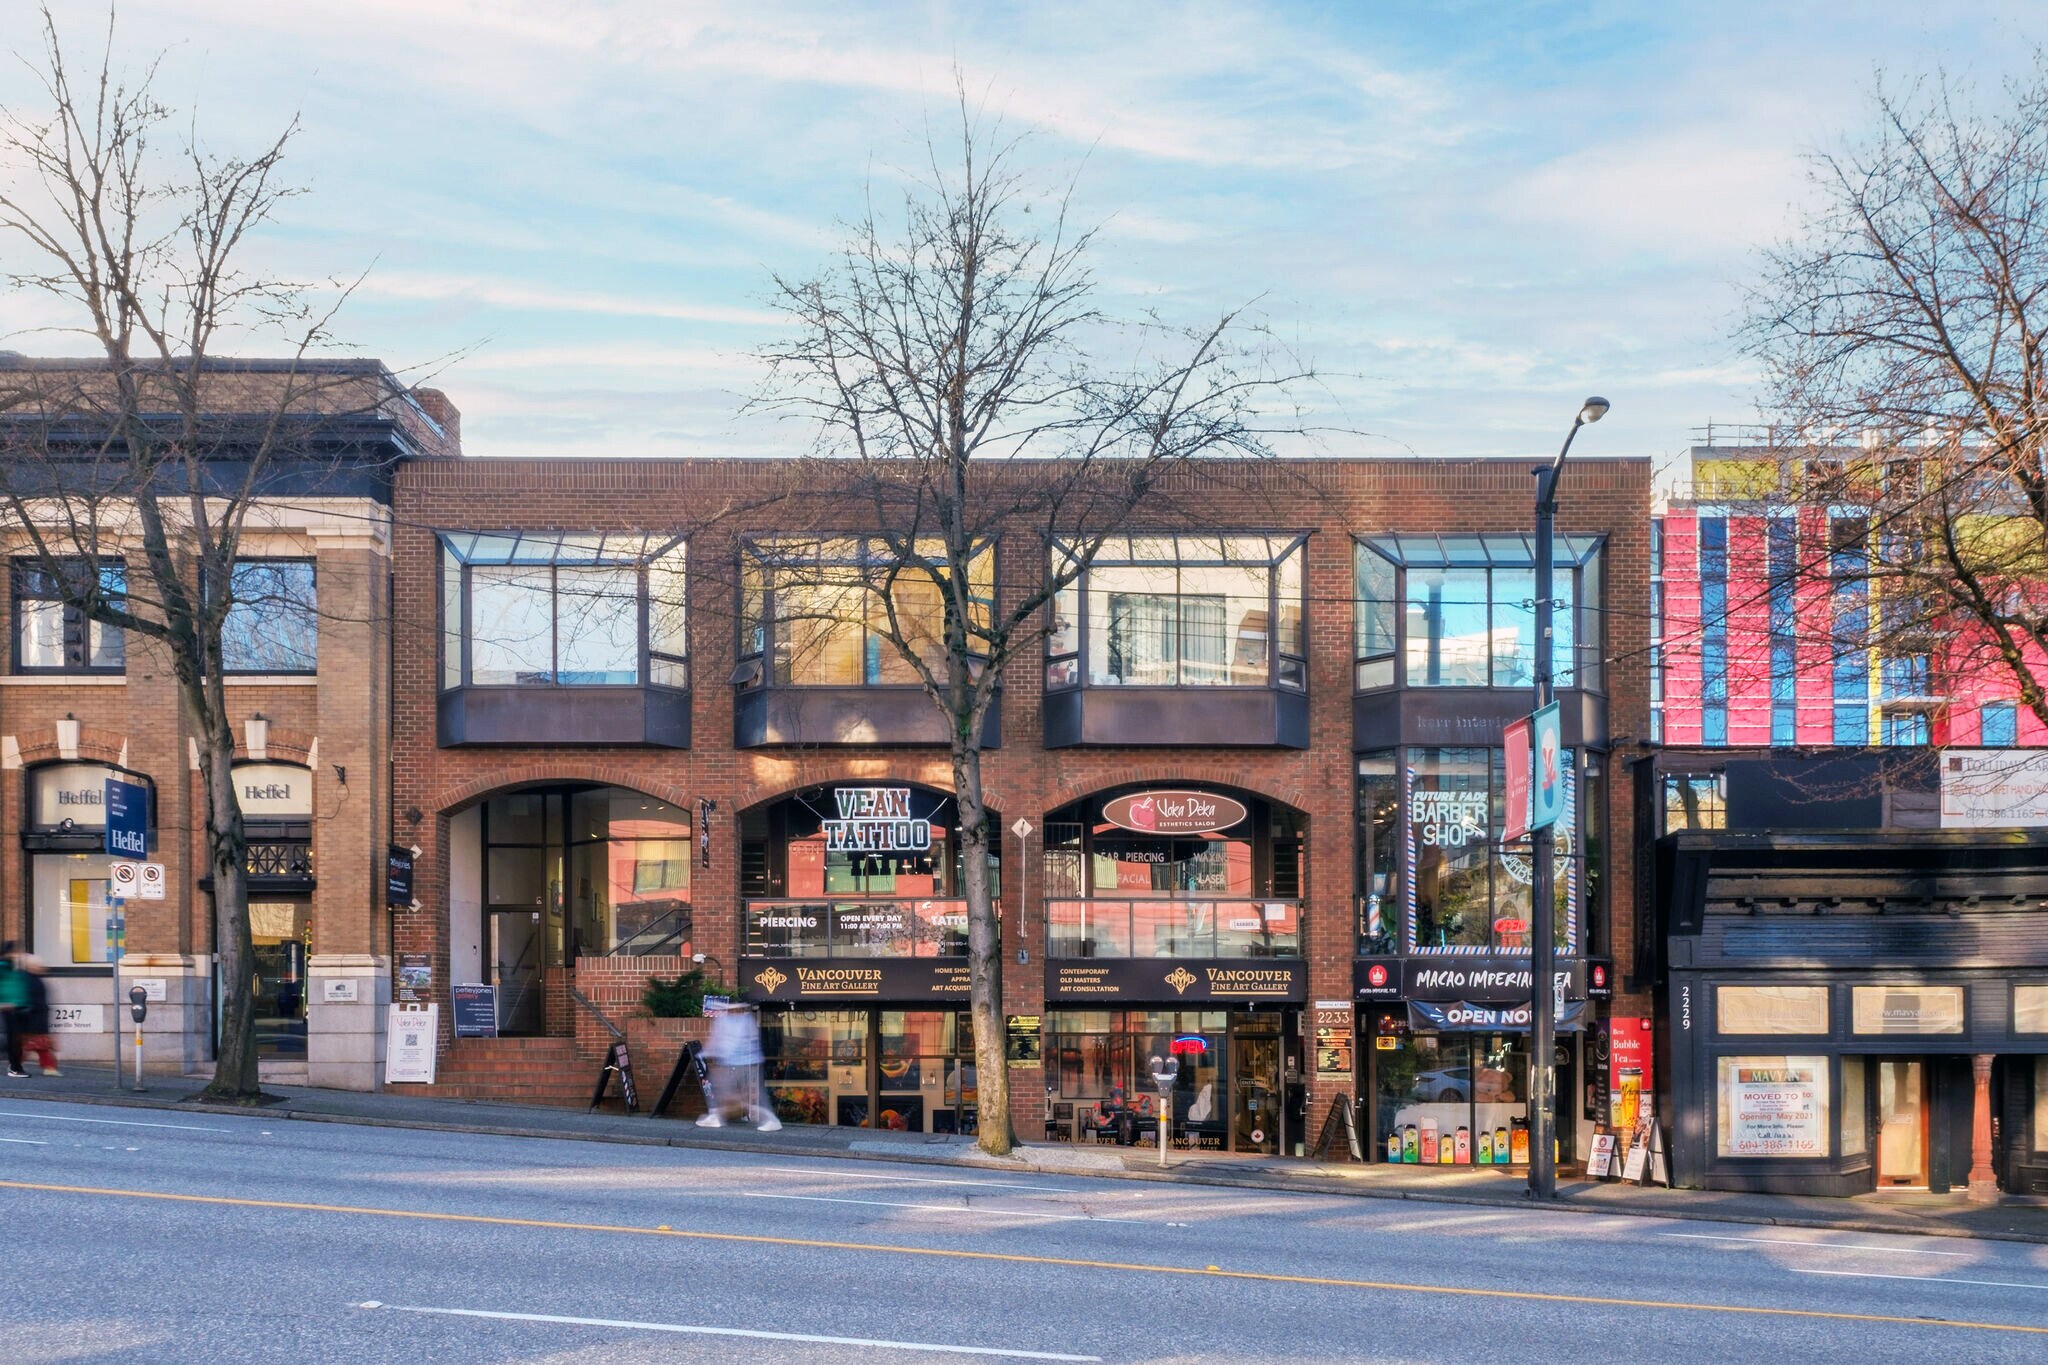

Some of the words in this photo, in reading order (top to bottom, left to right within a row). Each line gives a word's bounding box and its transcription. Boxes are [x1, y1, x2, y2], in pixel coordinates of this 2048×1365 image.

[58, 789, 102, 805] Heffel
[245, 783, 291, 800] Heffel
[1414, 791, 1456, 801] FUTURE
[1459, 791, 1488, 801] FADE
[834, 788, 910, 819] VEAN
[1157, 798, 1184, 818] Voka
[1187, 798, 1215, 817] Deka
[1413, 802, 1488, 823] BARBER
[112, 829, 144, 853] Heffel
[821, 820, 930, 851] TATTOO
[1423, 824, 1475, 846] SHOP
[1101, 852, 1119, 862] EAR
[1126, 852, 1165, 862] PIERCING
[1117, 874, 1151, 884] FACIAL
[1197, 873, 1225, 884] LASER
[760, 917, 817, 928] PIERCING
[931, 915, 968, 926] TATTO
[1494, 918, 1527, 933] OPEN
[797, 967, 882, 980] VANCOUVER
[1206, 968, 1292, 981] VANCOUVER
[1416, 969, 1465, 988] MACAO
[1468, 970, 1531, 988] IMPERIA
[1555, 971, 1572, 989] EA
[801, 981, 822, 990] FINE
[822, 981, 840, 990] ART
[841, 981, 879, 990] GALLERY
[1211, 982, 1231, 990] FINE
[1232, 982, 1250, 990] ART
[1251, 982, 1288, 990] GALLERY
[55, 1009, 82, 1020] 2247
[1682, 986, 1690, 1030] 2229
[1317, 1011, 1350, 1024] 2233
[1447, 1010, 1496, 1024] OPEN
[1501, 1010, 1531, 1024] NO
[1170, 1040, 1205, 1055] OPEN
[1613, 1039, 1640, 1049] Bubble
[1613, 1053, 1628, 1063] Tea
[1752, 1070, 1800, 1082] MAVYAN
[1744, 1093, 1781, 1101] MOVED
[1739, 1113, 1772, 1122] Opening
[1776, 1113, 1793, 1121] May
[1795, 1112, 1813, 1120] 2021
